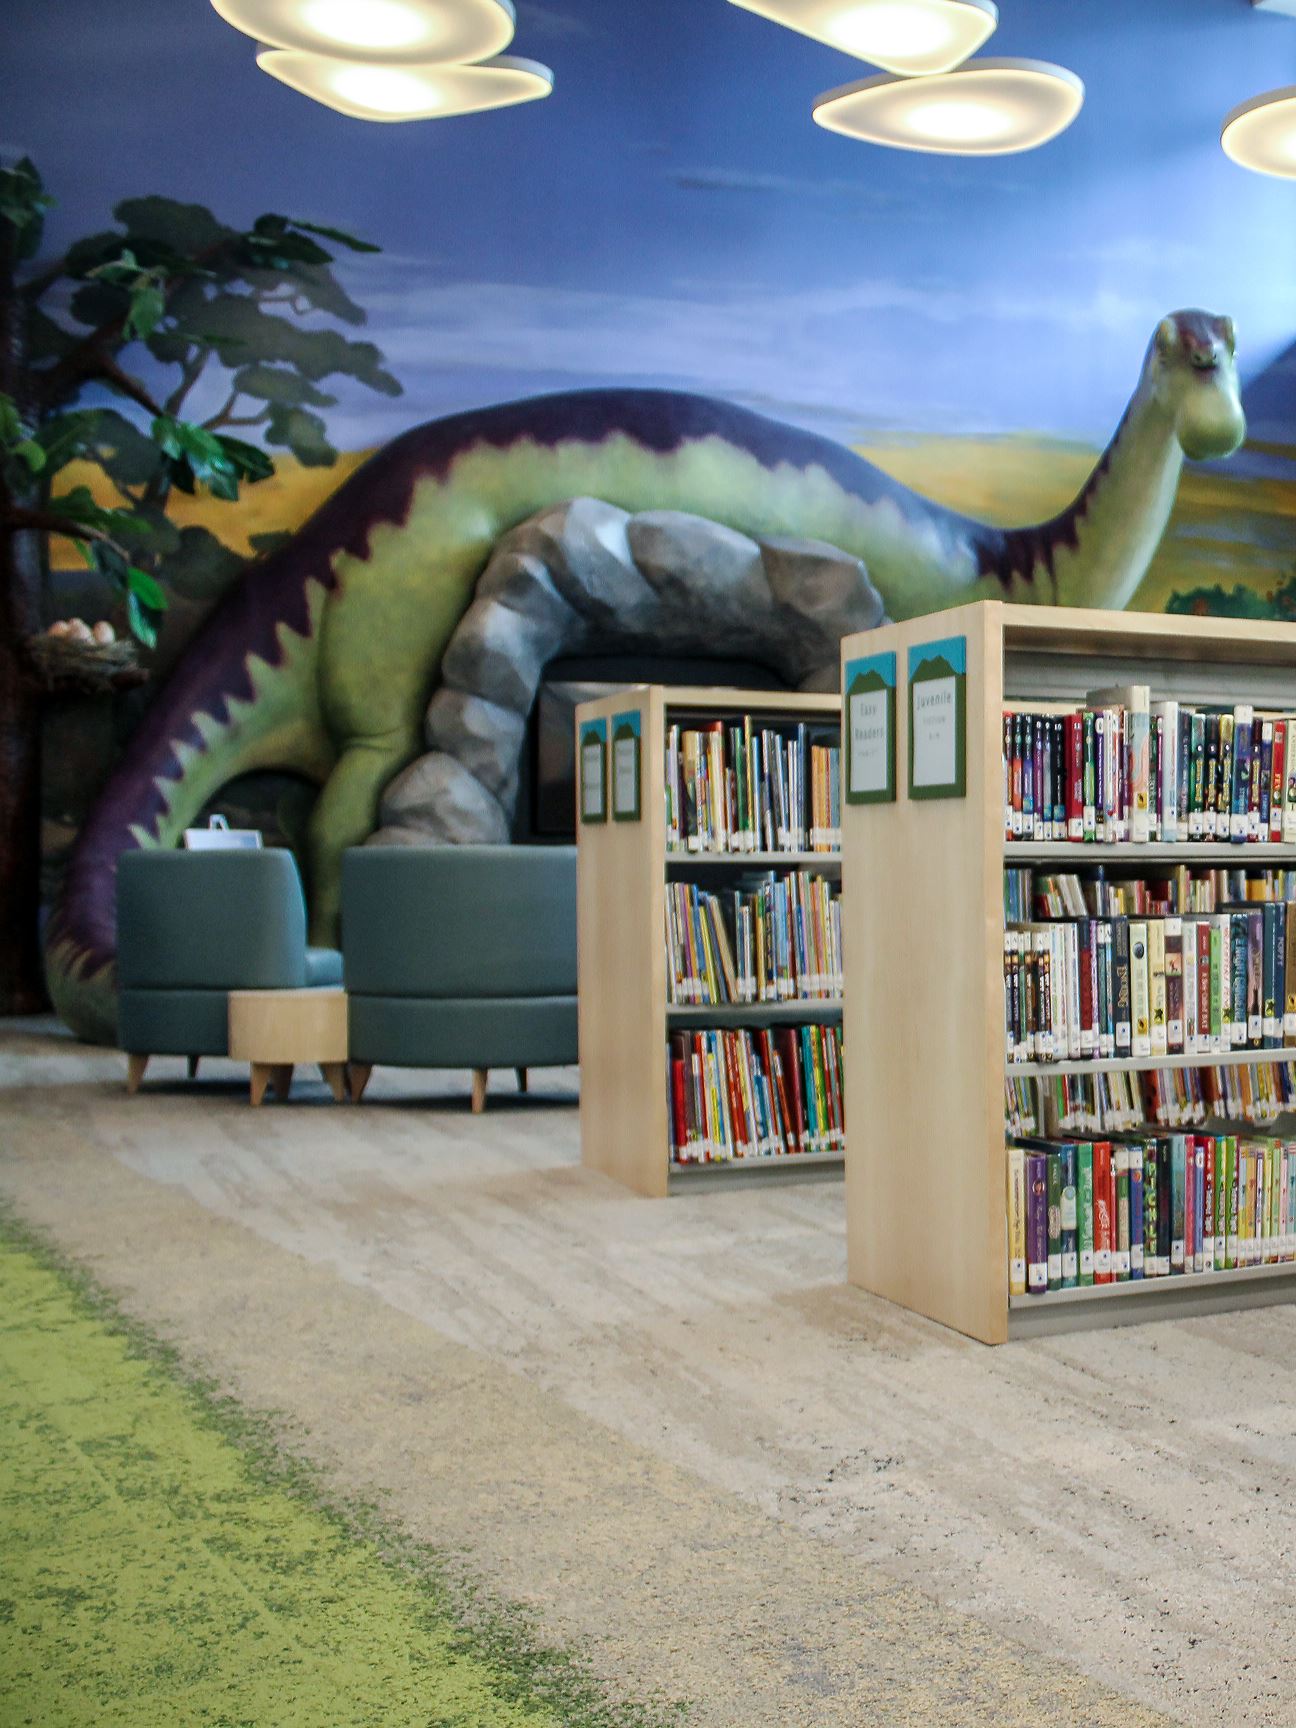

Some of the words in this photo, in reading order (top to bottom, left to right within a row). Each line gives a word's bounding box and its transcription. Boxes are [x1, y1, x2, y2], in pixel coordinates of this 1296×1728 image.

[916, 690, 952, 711] Juvenile
[860, 703, 877, 717] Easy
[853, 727, 883, 741] Readers
[1054, 723, 1062, 731] 10
